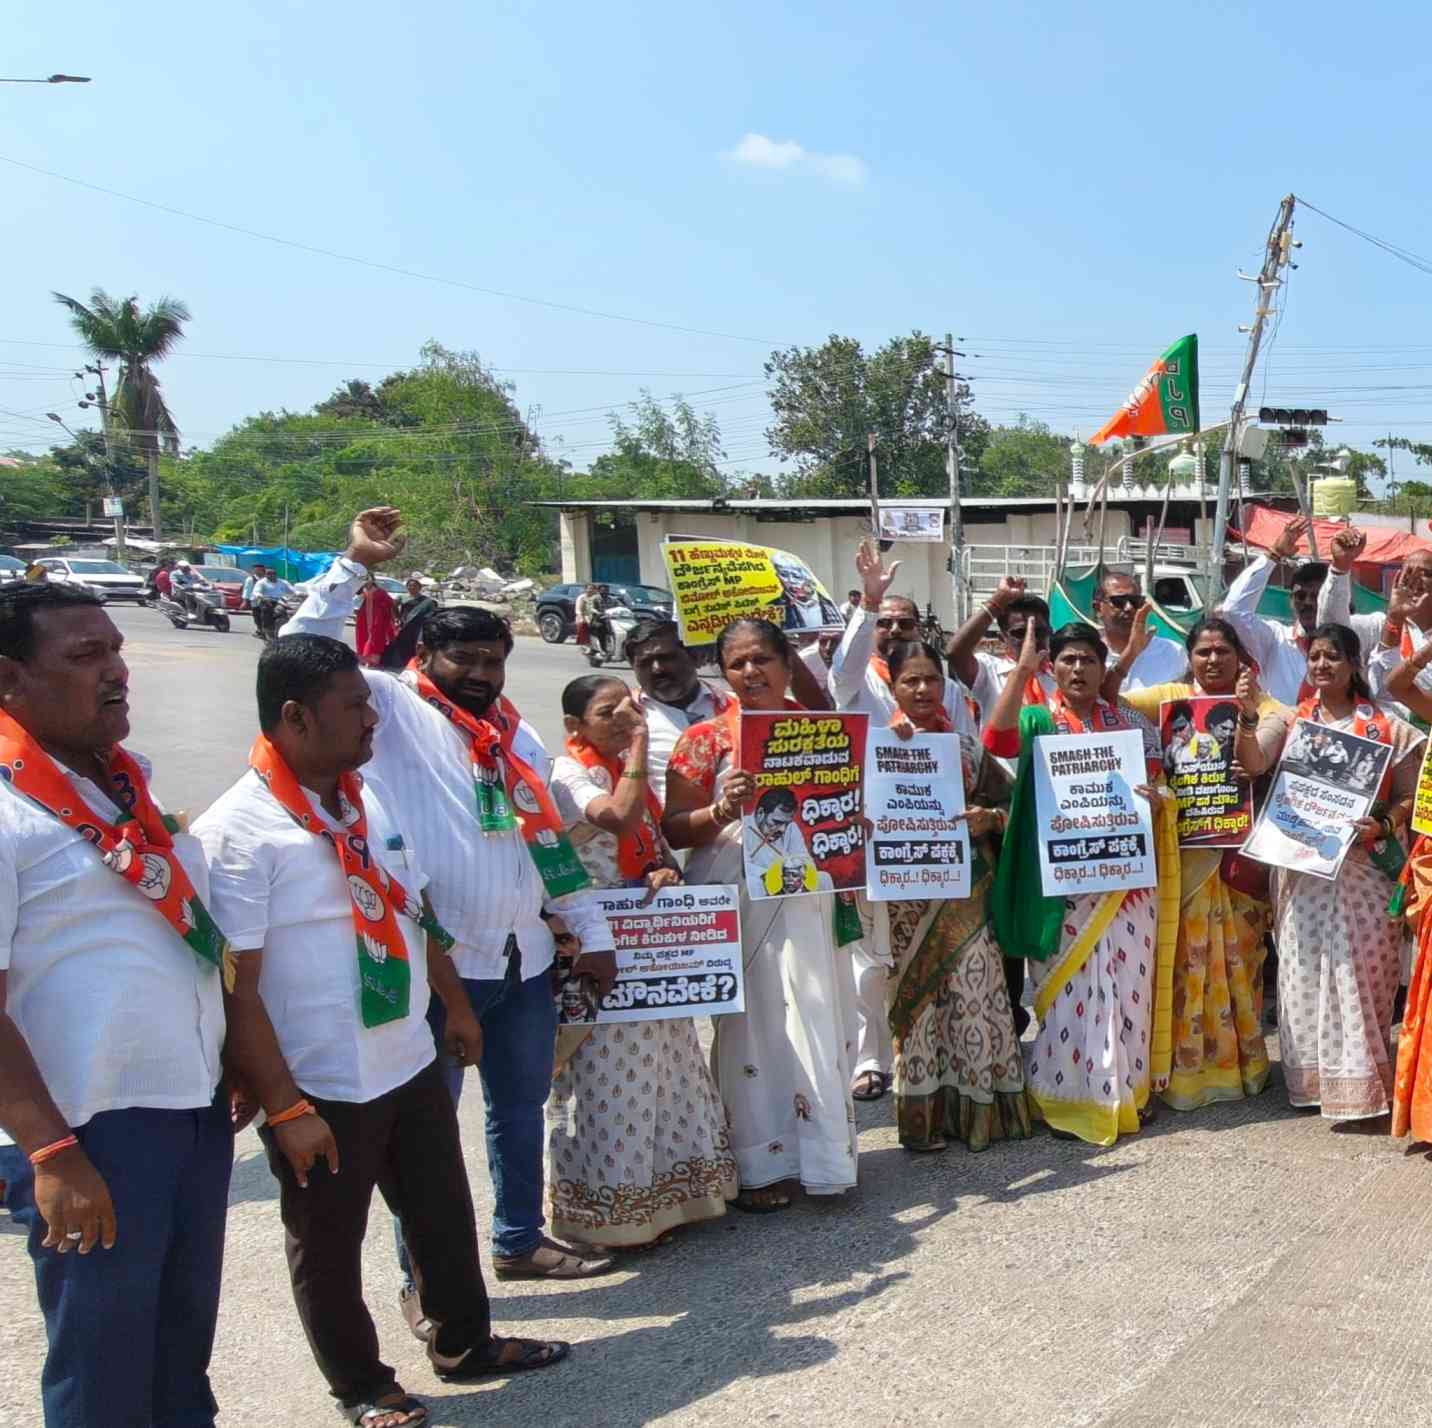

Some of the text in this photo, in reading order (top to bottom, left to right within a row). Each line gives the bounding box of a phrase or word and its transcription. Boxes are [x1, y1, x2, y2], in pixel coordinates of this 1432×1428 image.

[669, 549, 685, 562] 11
[775, 718, 842, 738] ಮಹಿಳಾ
[877, 761, 938, 774] PATRIARCHY
[1051, 758, 1122, 776] PATRIARCHY
[755, 768, 813, 787] ರಾಹುಲ್
[1069, 780, 1114, 795] ಕಾಮುಕ
[802, 788, 861, 825] ಧಿಕ್ಕಾರ!
[812, 824, 863, 859] ಧಿಕ್ಕಾರ!
[657, 894, 694, 909] ಗಾಂಧಿ
[602, 974, 735, 1009] ಮೌನವೇಕೆ?
